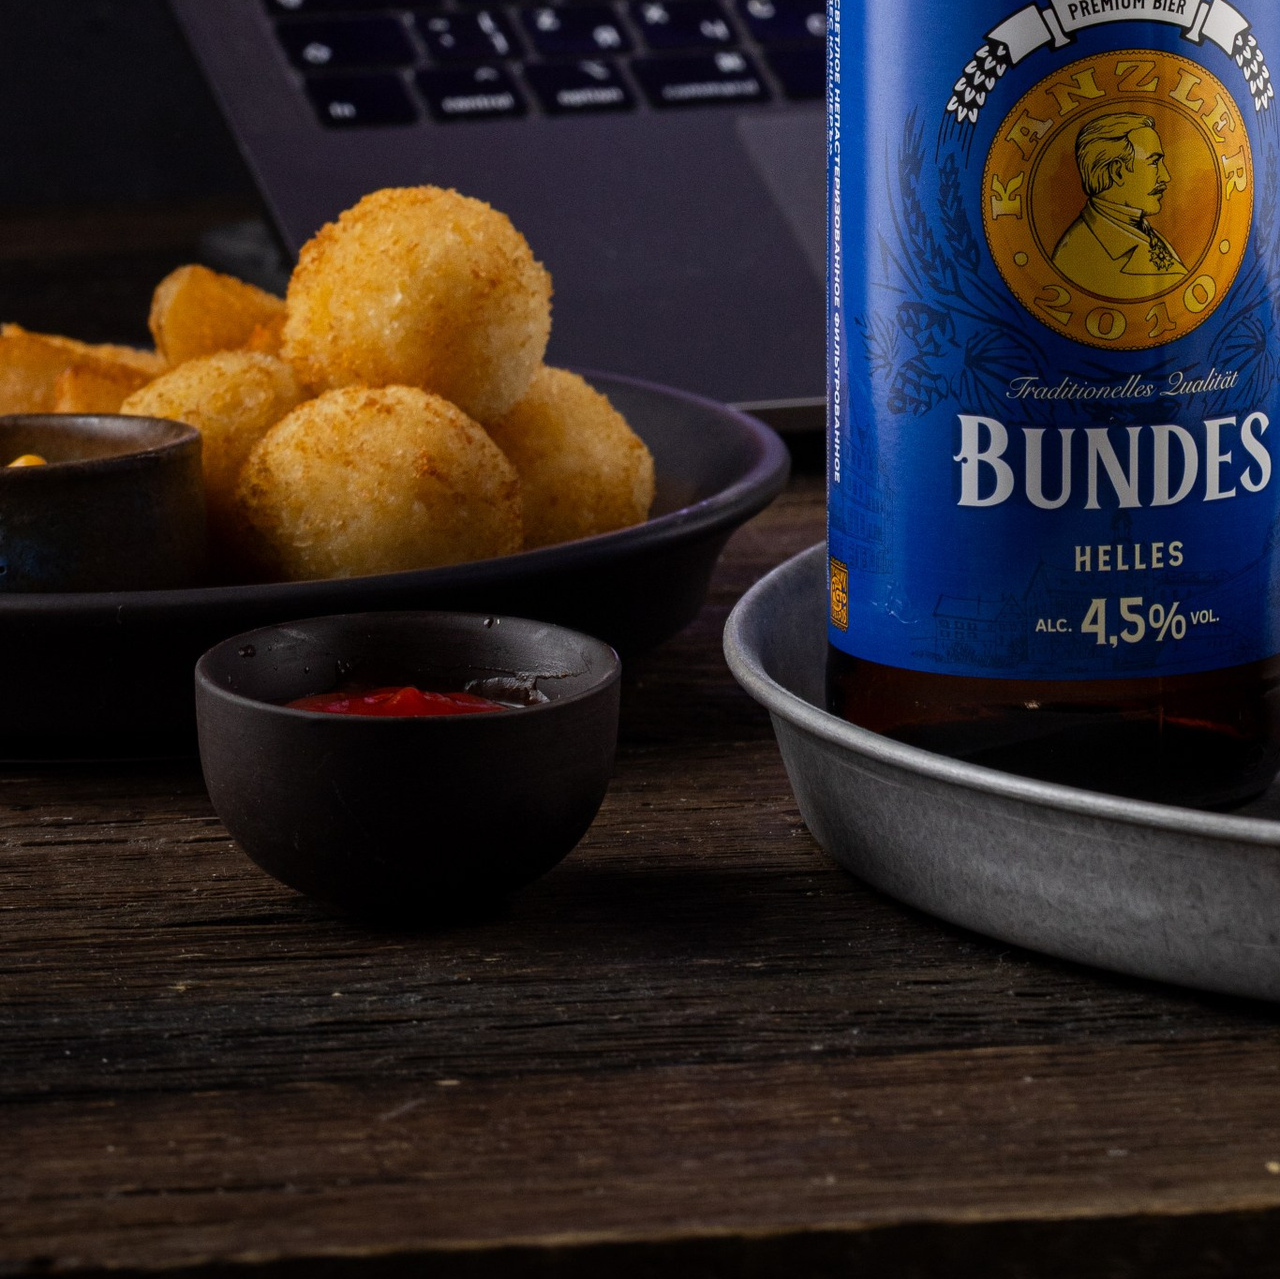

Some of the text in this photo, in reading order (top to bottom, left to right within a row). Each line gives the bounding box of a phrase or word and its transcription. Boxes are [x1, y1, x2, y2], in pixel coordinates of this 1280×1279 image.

[991, 59, 1249, 221] KANZLER
[833, 88, 841, 308] НЕПАСТЕРИЗОВАННОЕ
[1034, 274, 1218, 340] 2010
[833, 312, 841, 484] ФИЛЬТРОВАННОЕ
[1006, 367, 1240, 400] Traditionelles Qualität
[953, 411, 1272, 511] BUNDES
[1074, 540, 1184, 572] HELLES
[1035, 596, 1220, 648] ALC. 4,5% VOL.
